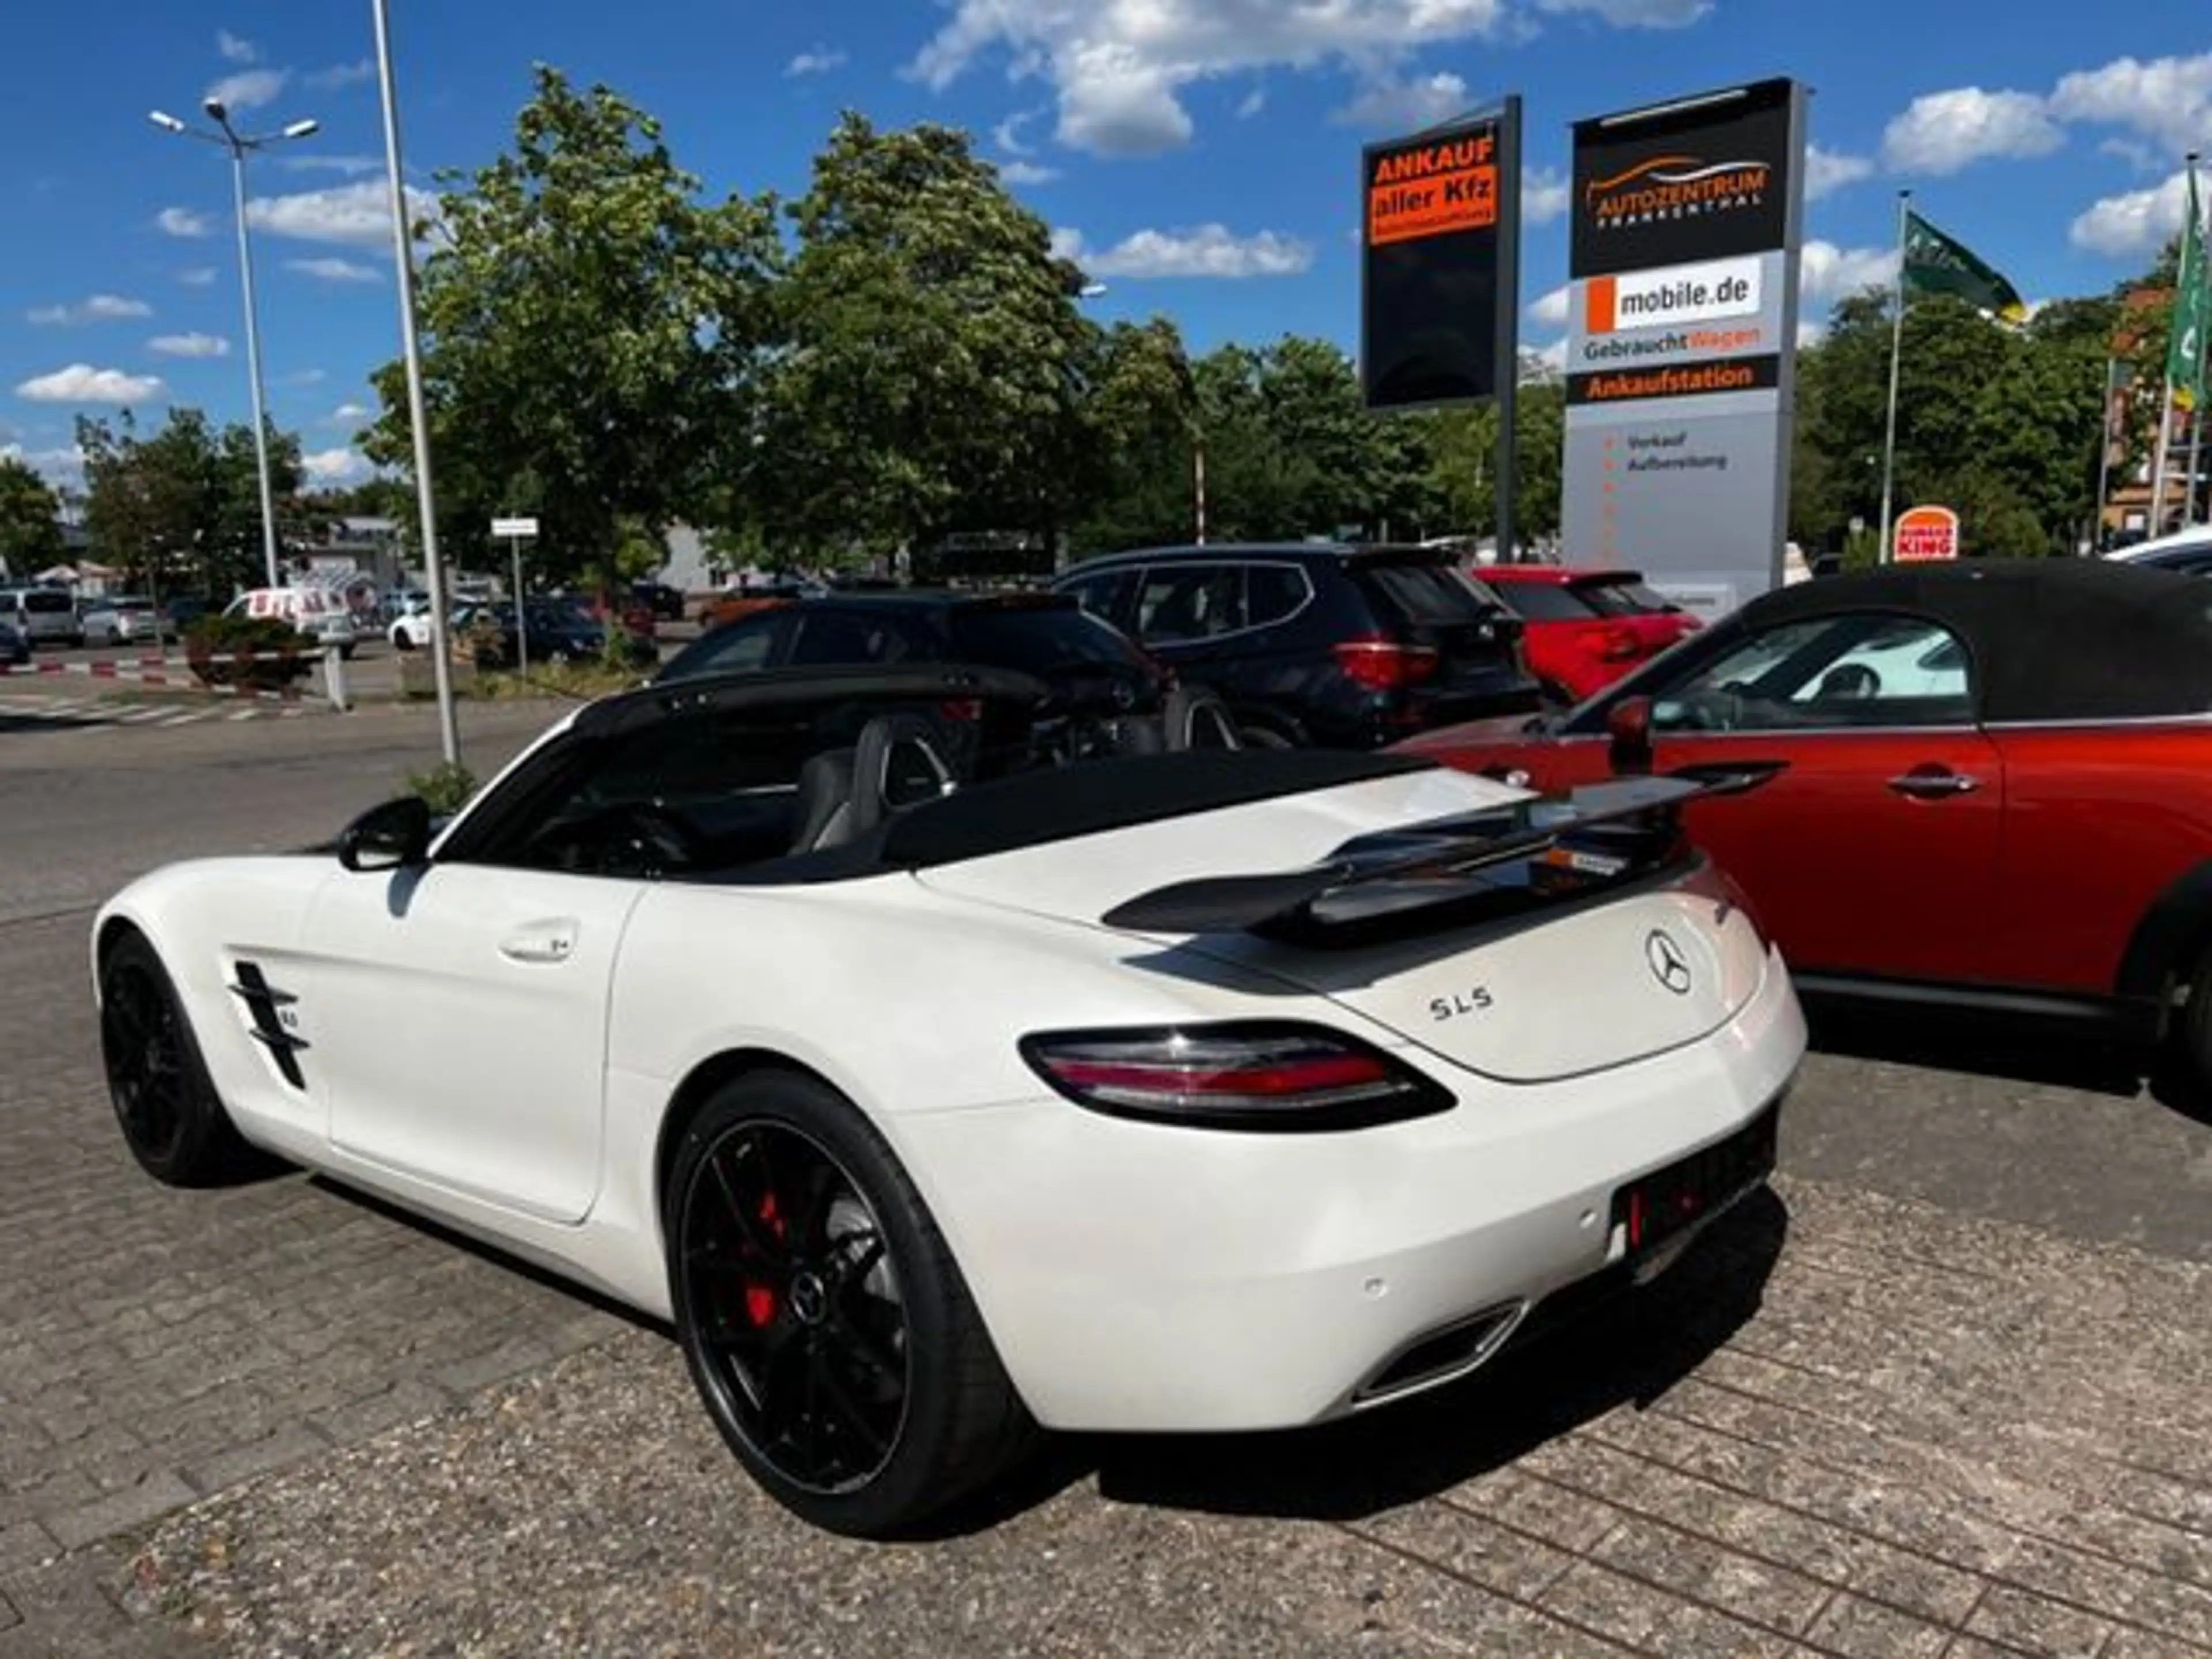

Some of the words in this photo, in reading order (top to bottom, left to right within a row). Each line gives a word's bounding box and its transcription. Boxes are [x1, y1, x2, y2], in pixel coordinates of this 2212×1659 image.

[1374, 136, 1494, 184] ANKAUF
[1375, 190, 1435, 217] aller
[1444, 175, 1490, 202] Kfz
[1596, 170, 1765, 215] AUTOZENTRUM
[1621, 276, 1749, 315] mobile.de
[1587, 366, 1753, 399] Ankaufstation
[1898, 538, 1952, 554] KING
[1430, 986, 1493, 1021] SLS
